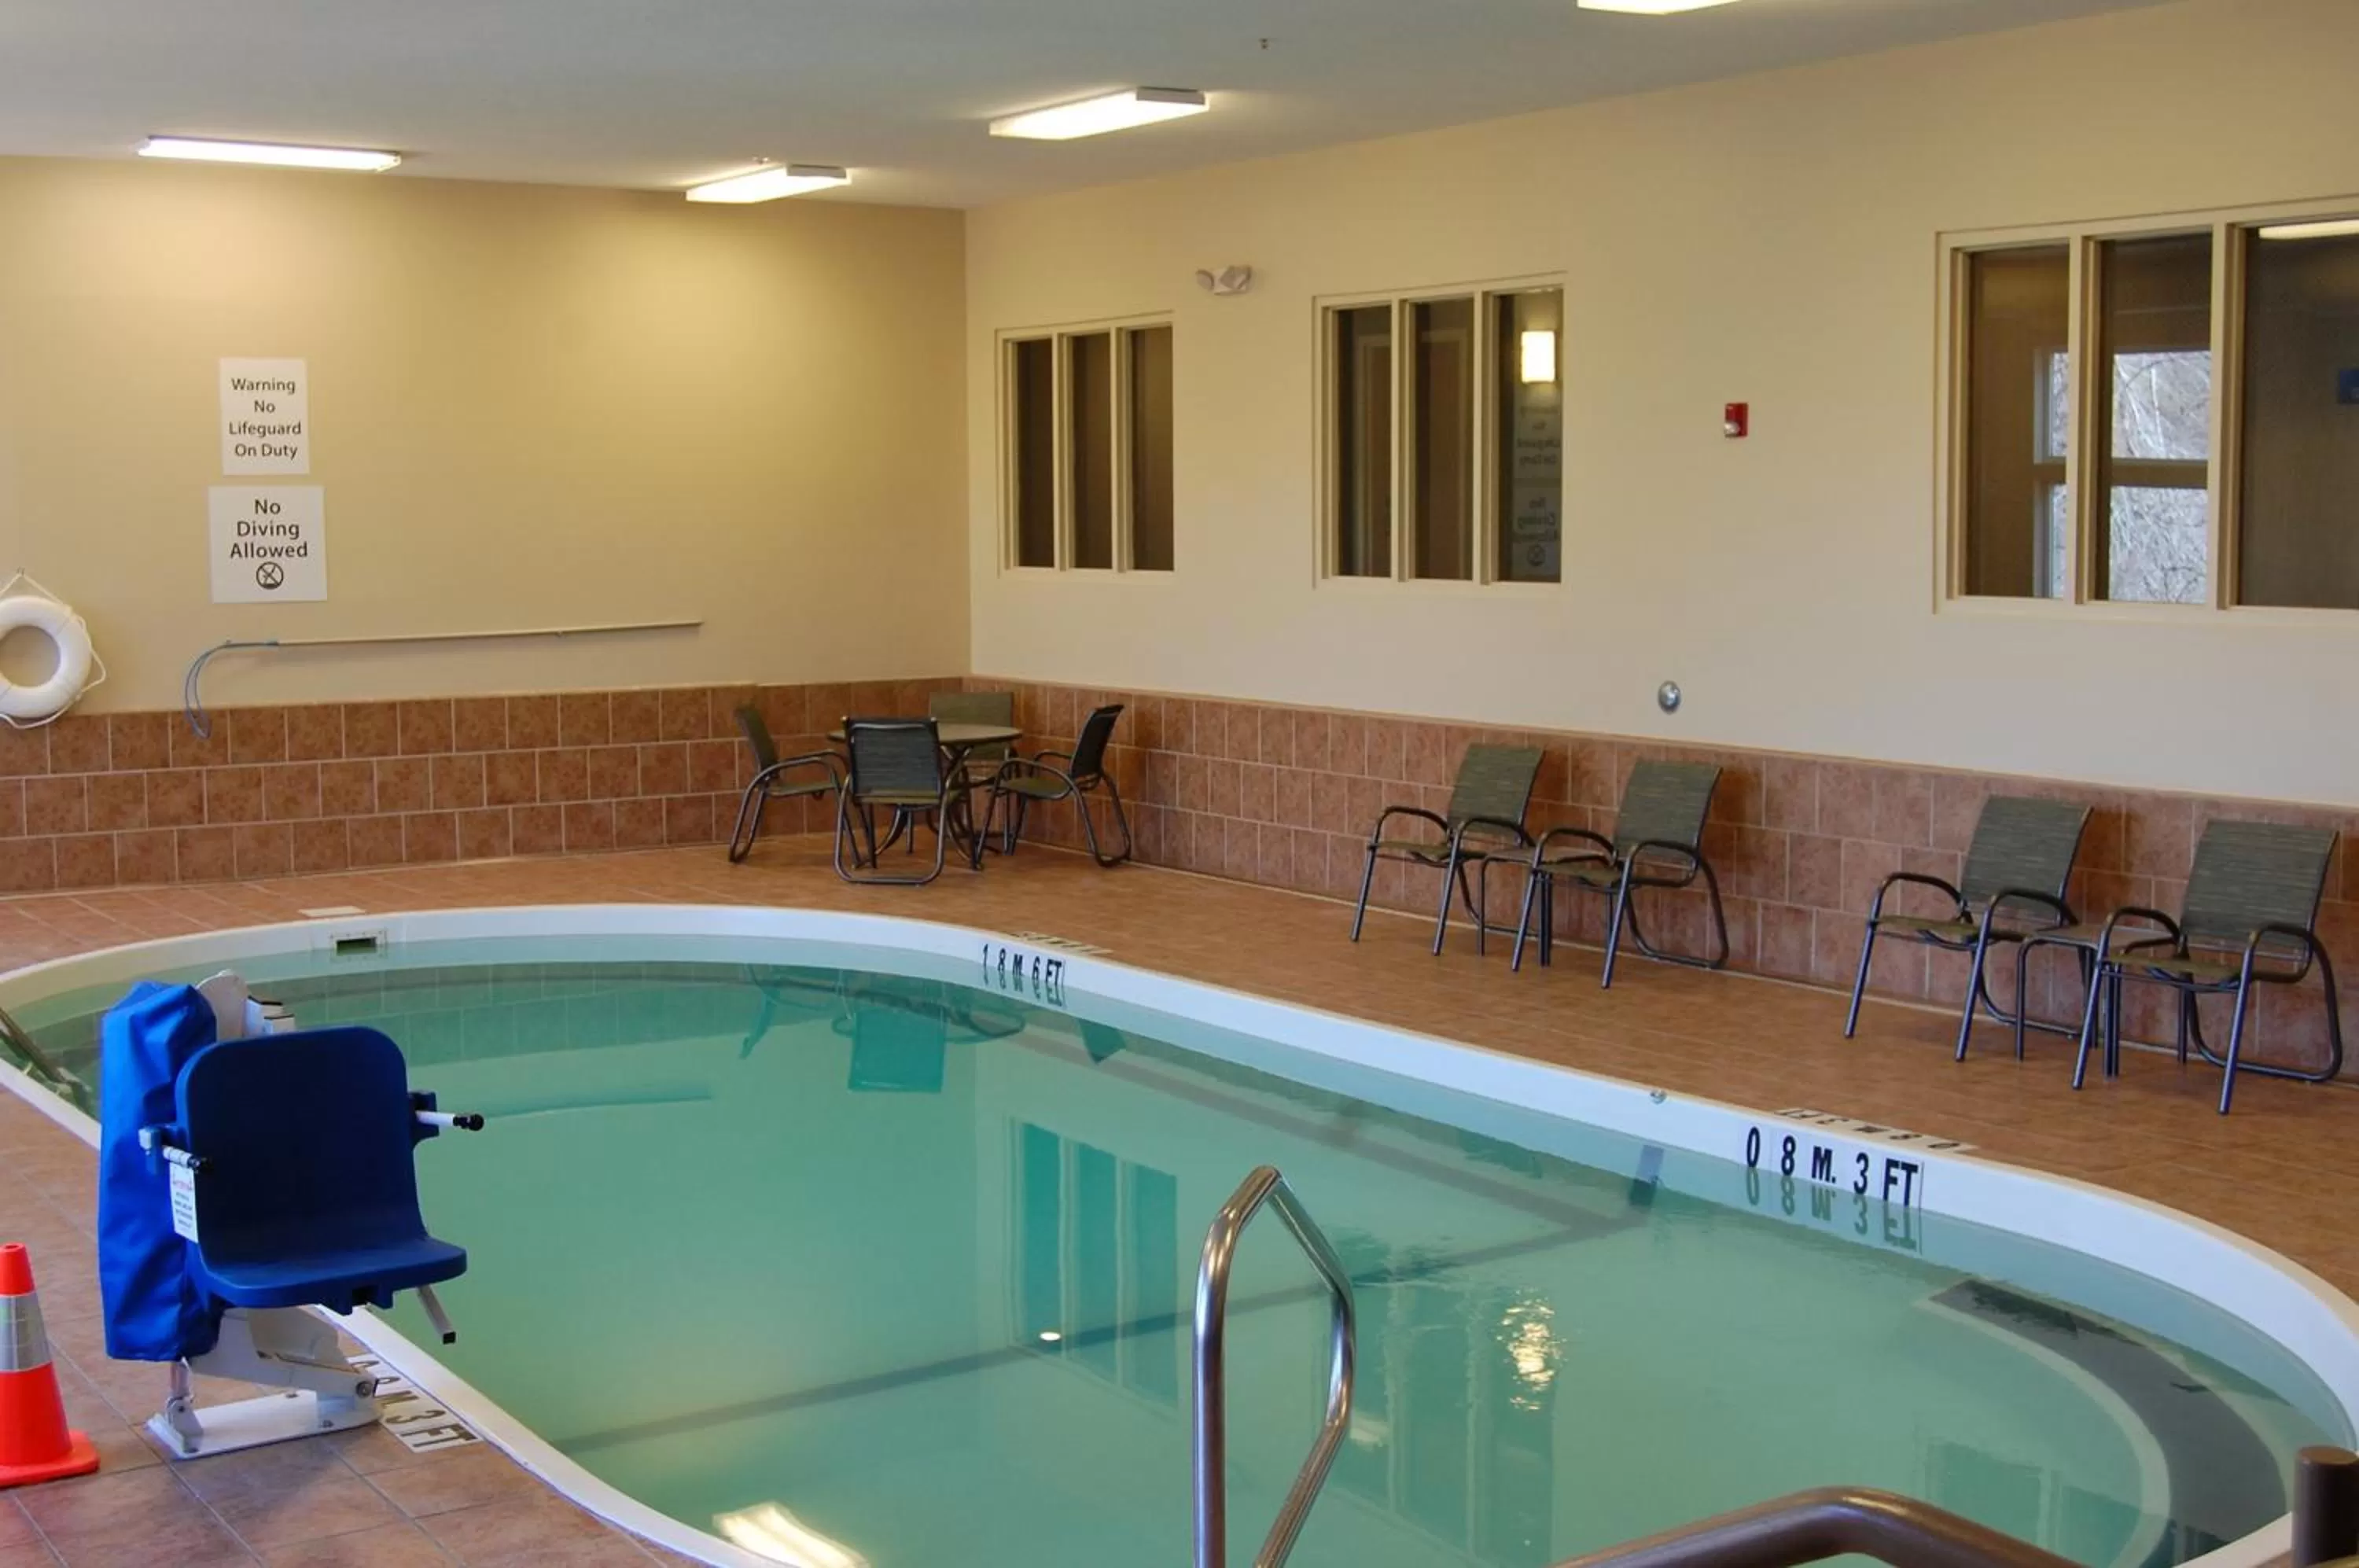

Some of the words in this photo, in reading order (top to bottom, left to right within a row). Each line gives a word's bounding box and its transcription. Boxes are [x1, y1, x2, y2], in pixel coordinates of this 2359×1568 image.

[230, 378, 296, 394] Warning
[254, 400, 275, 412] No
[229, 421, 302, 437] Lifeguard
[235, 444, 256, 457] On
[262, 444, 298, 460] Duty
[255, 499, 281, 514] No
[237, 521, 300, 539] Diving
[230, 543, 308, 558] Allowed
[1883, 1158, 1918, 1207] FT
[400, 1423, 478, 1448] FT
